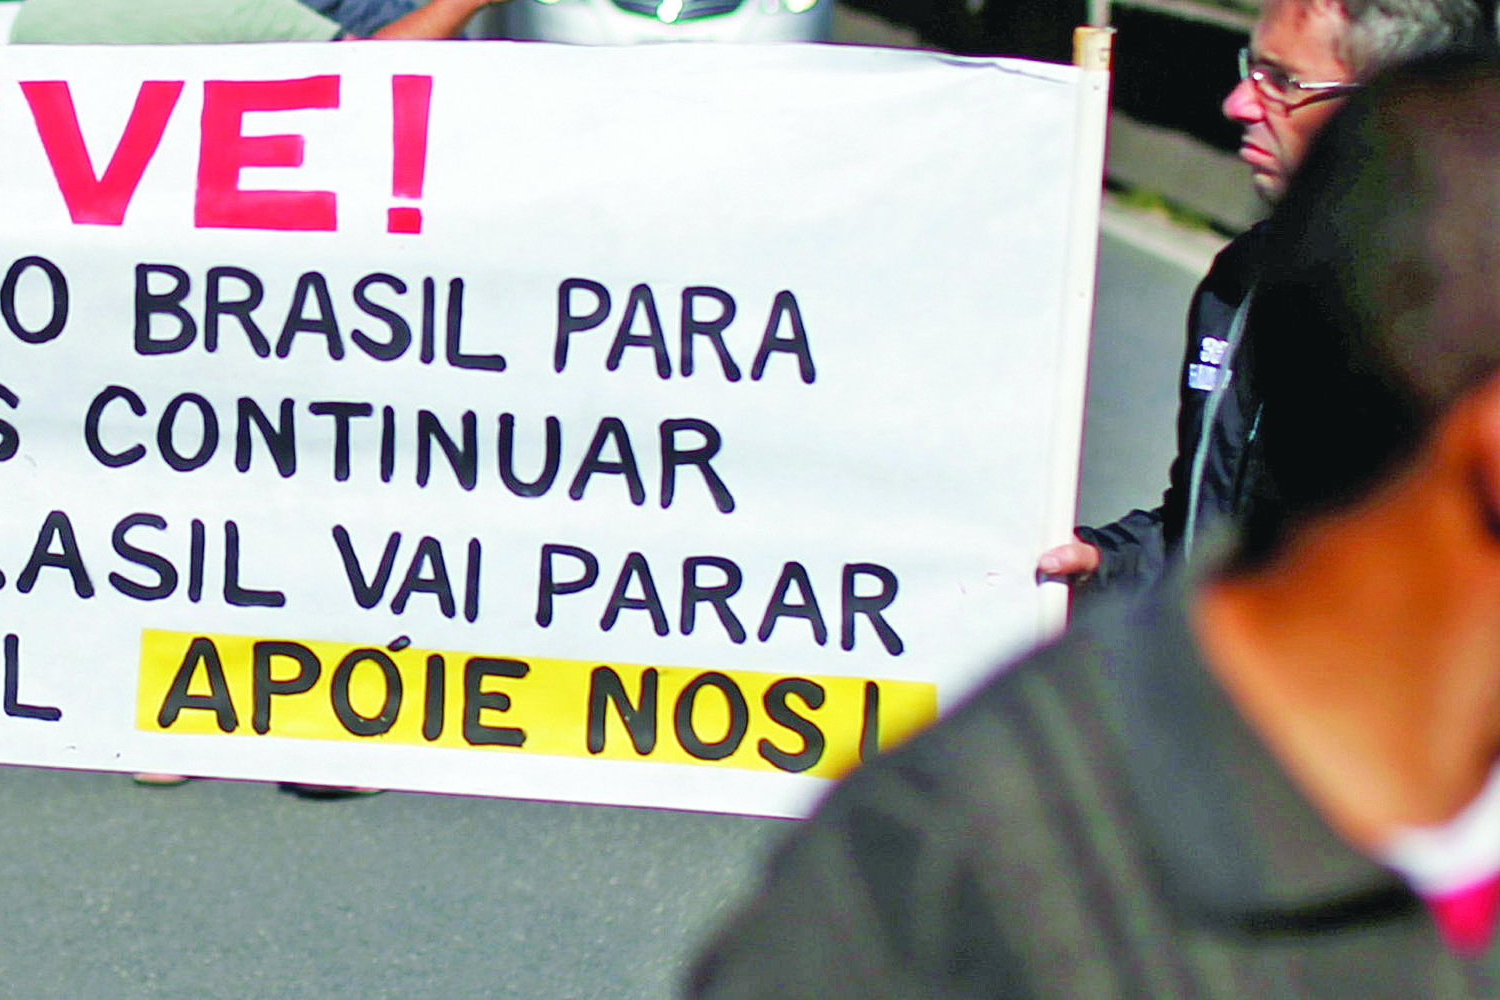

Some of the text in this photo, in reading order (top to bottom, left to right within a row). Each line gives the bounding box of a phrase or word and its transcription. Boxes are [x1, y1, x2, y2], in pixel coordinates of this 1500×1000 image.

[0, 255, 69, 344] O
[134, 263, 507, 372] BRASIL
[554, 279, 815, 384] PARA
[84, 385, 735, 514] CONTINUAR
[332, 525, 481, 623] VAI
[535, 543, 904, 656] PARAR
[157, 635, 530, 748] APÓIE
